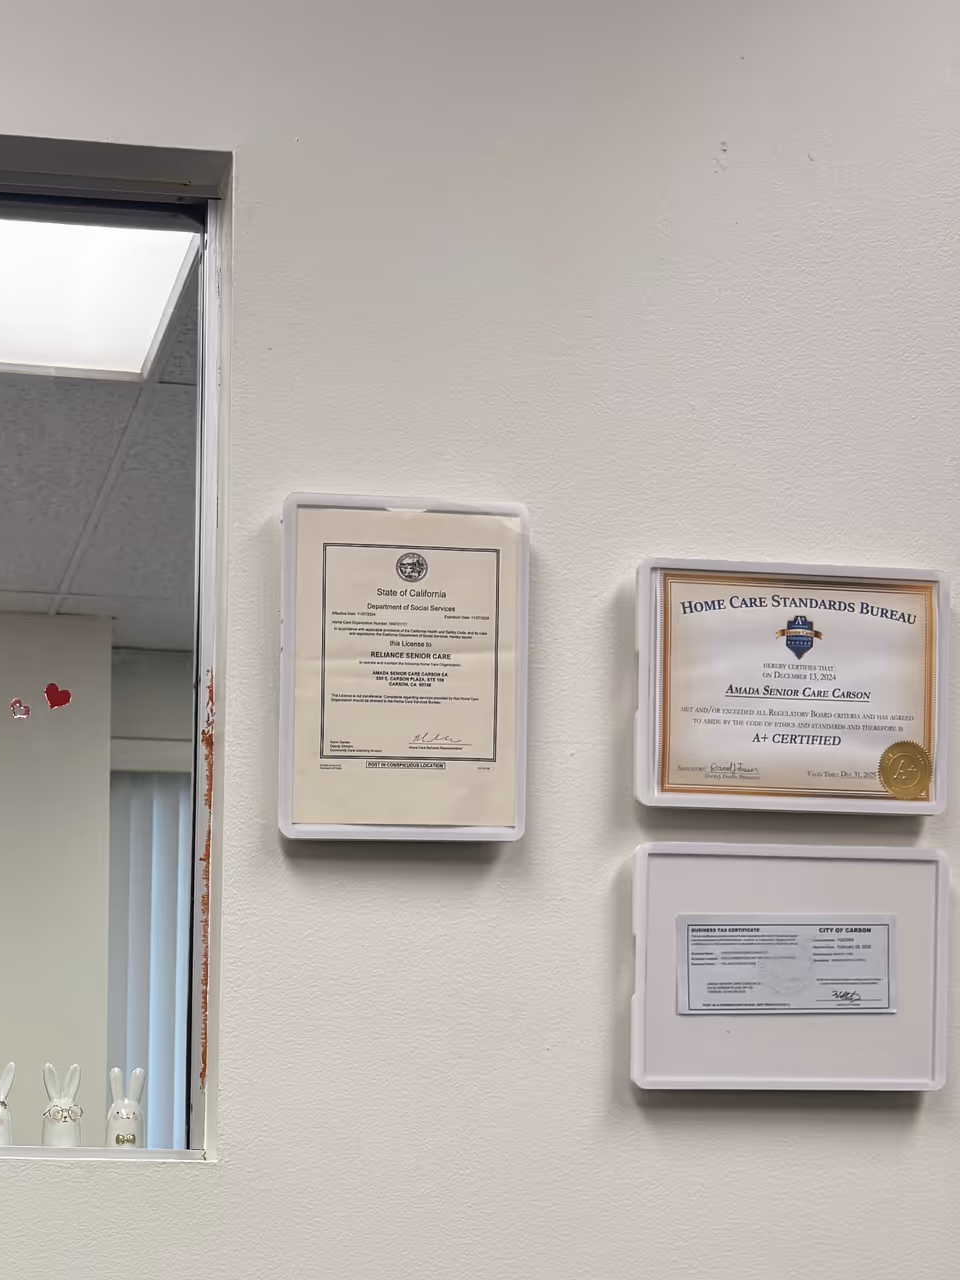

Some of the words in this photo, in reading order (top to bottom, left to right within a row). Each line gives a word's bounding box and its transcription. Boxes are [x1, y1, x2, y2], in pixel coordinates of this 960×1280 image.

[377, 588, 397, 596] State
[400, 589, 407, 597] of
[410, 590, 446, 598] California
[367, 603, 402, 611] Department
[726, 684, 759, 695] AMADA
[763, 685, 799, 697] SENIOR
[802, 687, 828, 697] CARE
[832, 689, 871, 699] CARSON
[752, 733, 769, 743] A+
[772, 734, 841, 746] CERTIFIED
